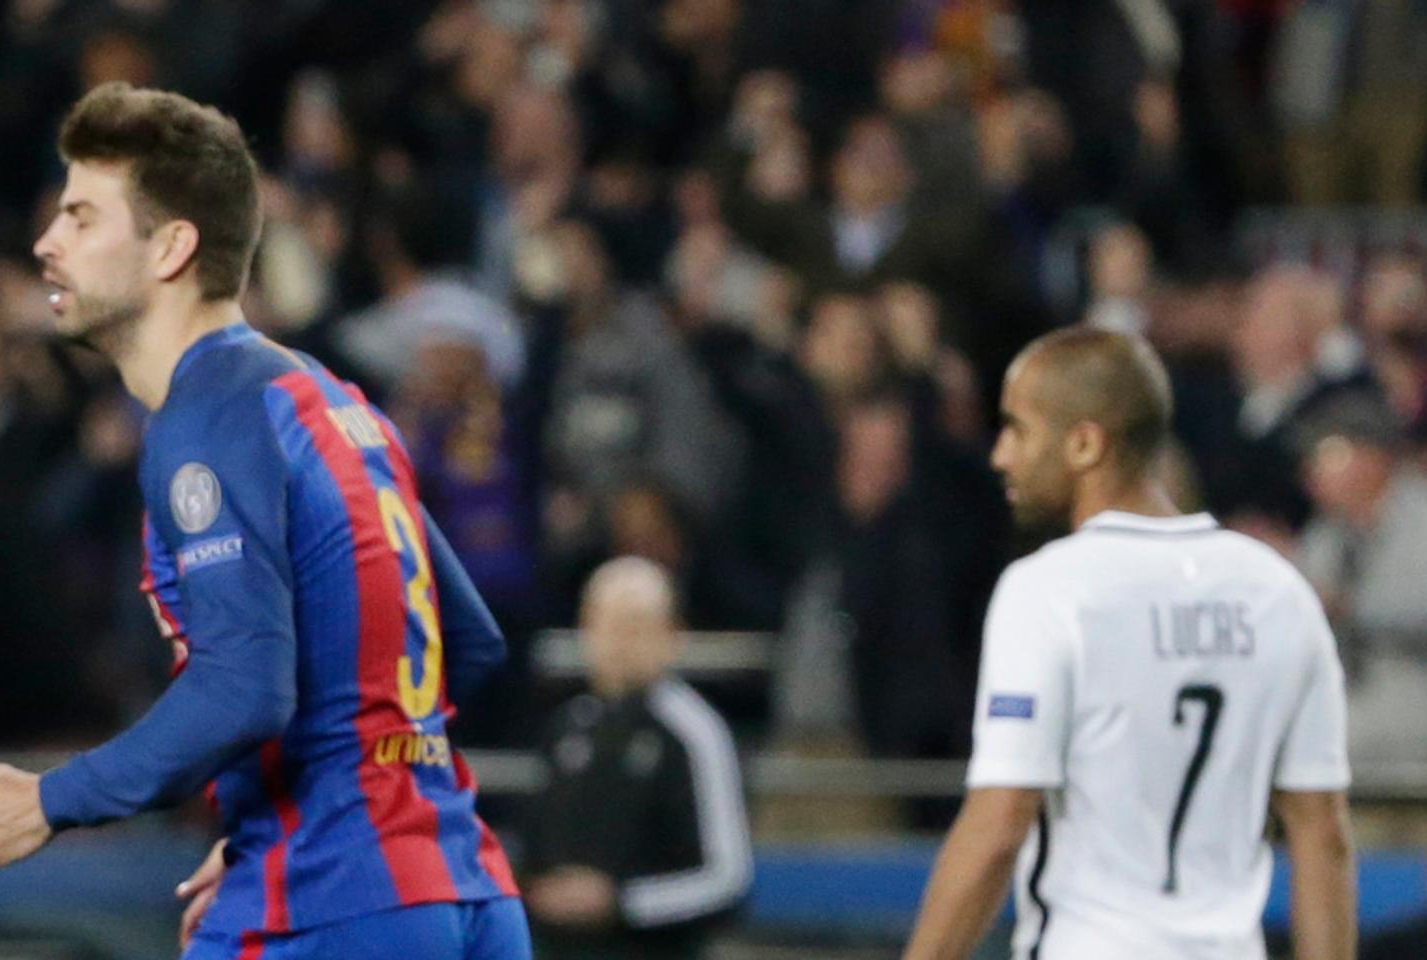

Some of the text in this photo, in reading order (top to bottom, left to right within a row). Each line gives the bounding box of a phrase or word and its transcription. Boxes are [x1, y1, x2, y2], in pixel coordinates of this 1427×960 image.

[376, 487, 443, 720] 3
[1149, 598, 1257, 660] LUCAS
[1162, 681, 1224, 894] 7
